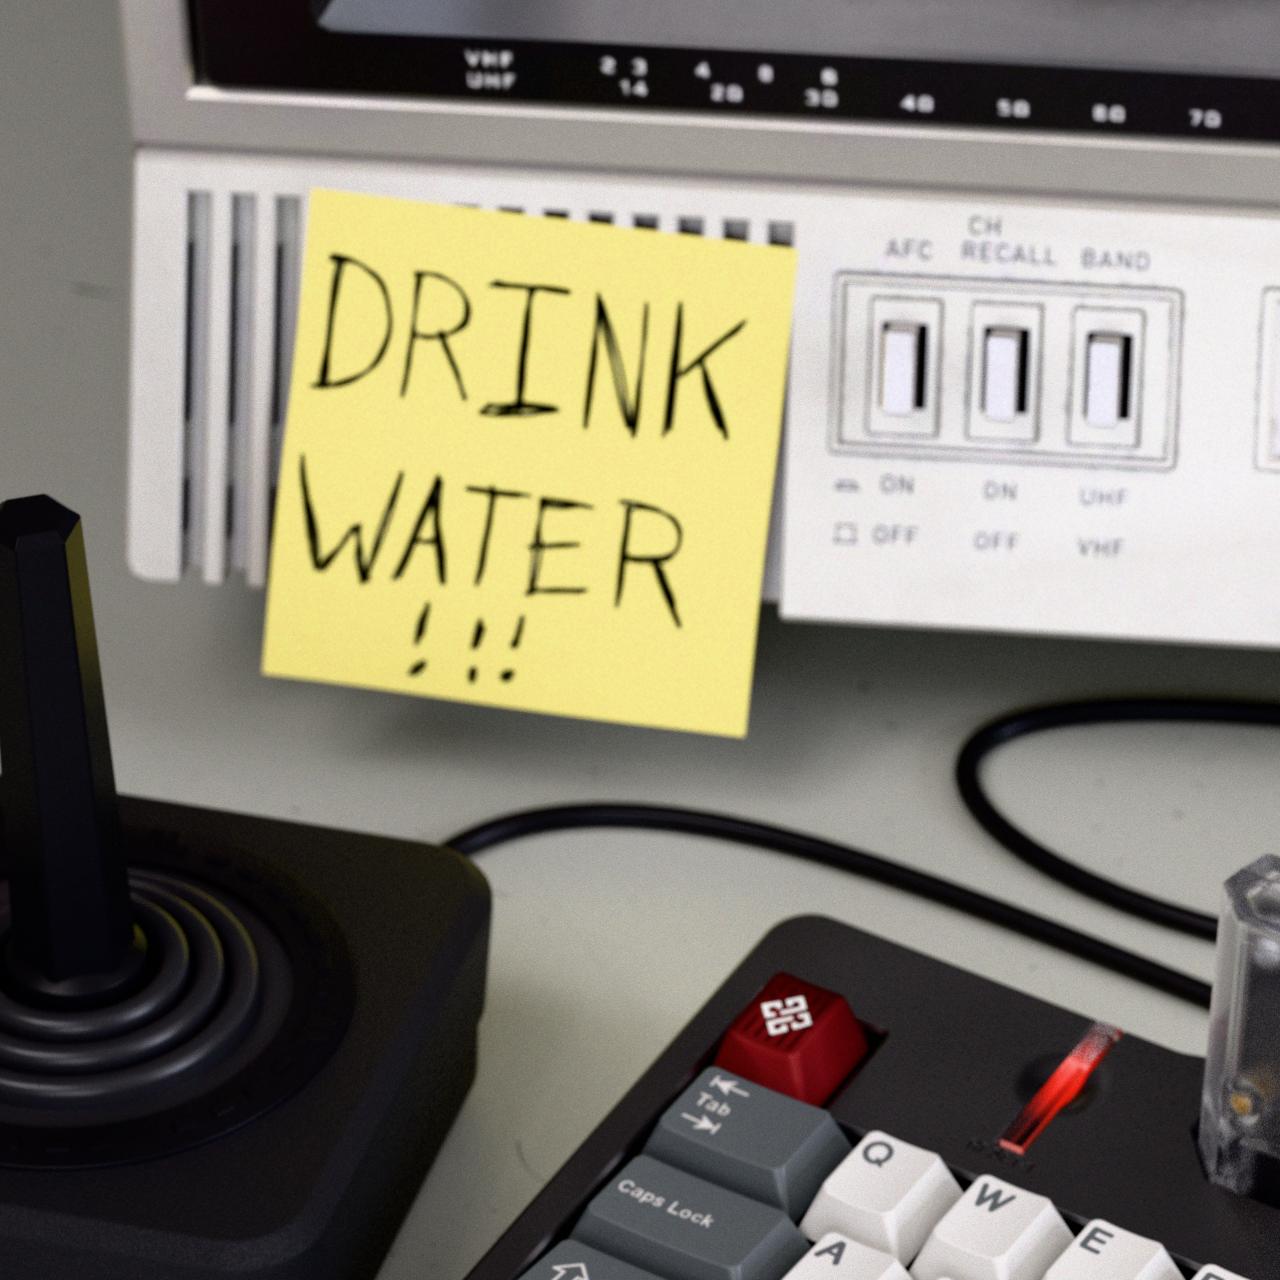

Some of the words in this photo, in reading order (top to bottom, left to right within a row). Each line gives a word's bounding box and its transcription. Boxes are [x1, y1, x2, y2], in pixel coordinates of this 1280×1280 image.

[967, 215, 1003, 236] CH
[885, 238, 931, 261] AFC
[961, 240, 1054, 266] RECALL
[1080, 247, 1150, 271] BAND
[310, 253, 749, 440] DRINK
[879, 473, 915, 494] ON
[983, 481, 1017, 500] ON
[1079, 488, 1125, 506] UHF
[299, 452, 684, 629] WATER
[871, 524, 918, 545] OFF
[973, 531, 1016, 551] OFF
[1078, 538, 1122, 557] VHF
[407, 601, 526, 684] !!!
[695, 1091, 732, 1118] Tab
[863, 1141, 894, 1167] Q
[617, 1179, 666, 1207] Caps
[666, 1200, 713, 1228] Lock
[975, 1183, 1015, 1212] W
[1080, 1227, 1114, 1254] E
[815, 1241, 846, 1265] A
